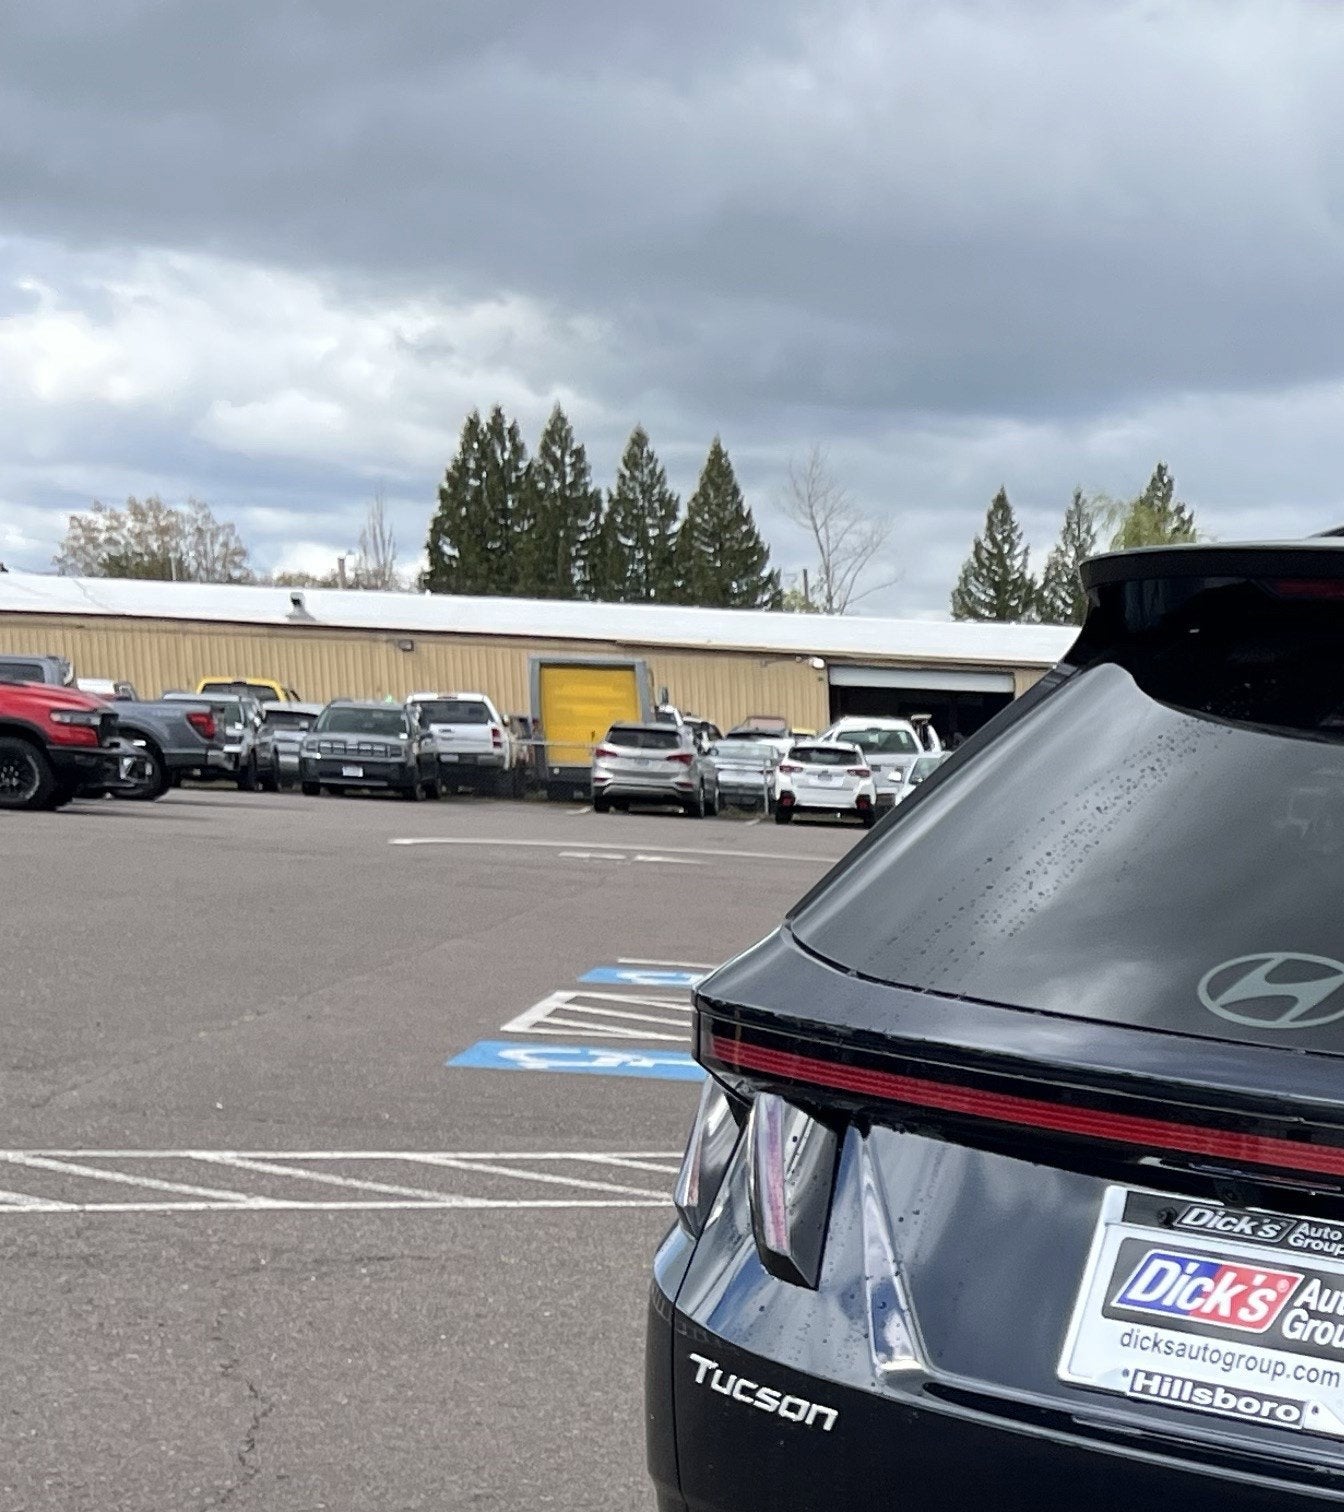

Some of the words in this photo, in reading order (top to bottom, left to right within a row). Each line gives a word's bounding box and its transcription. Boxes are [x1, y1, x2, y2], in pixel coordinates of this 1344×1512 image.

[1181, 1207, 1282, 1239] Dick's
[1294, 1222, 1343, 1242] Auto
[1127, 1257, 1279, 1323] Dick's
[1119, 1327, 1341, 1389] dicksautogroup.com
[1133, 1369, 1301, 1423] Hillsboro
